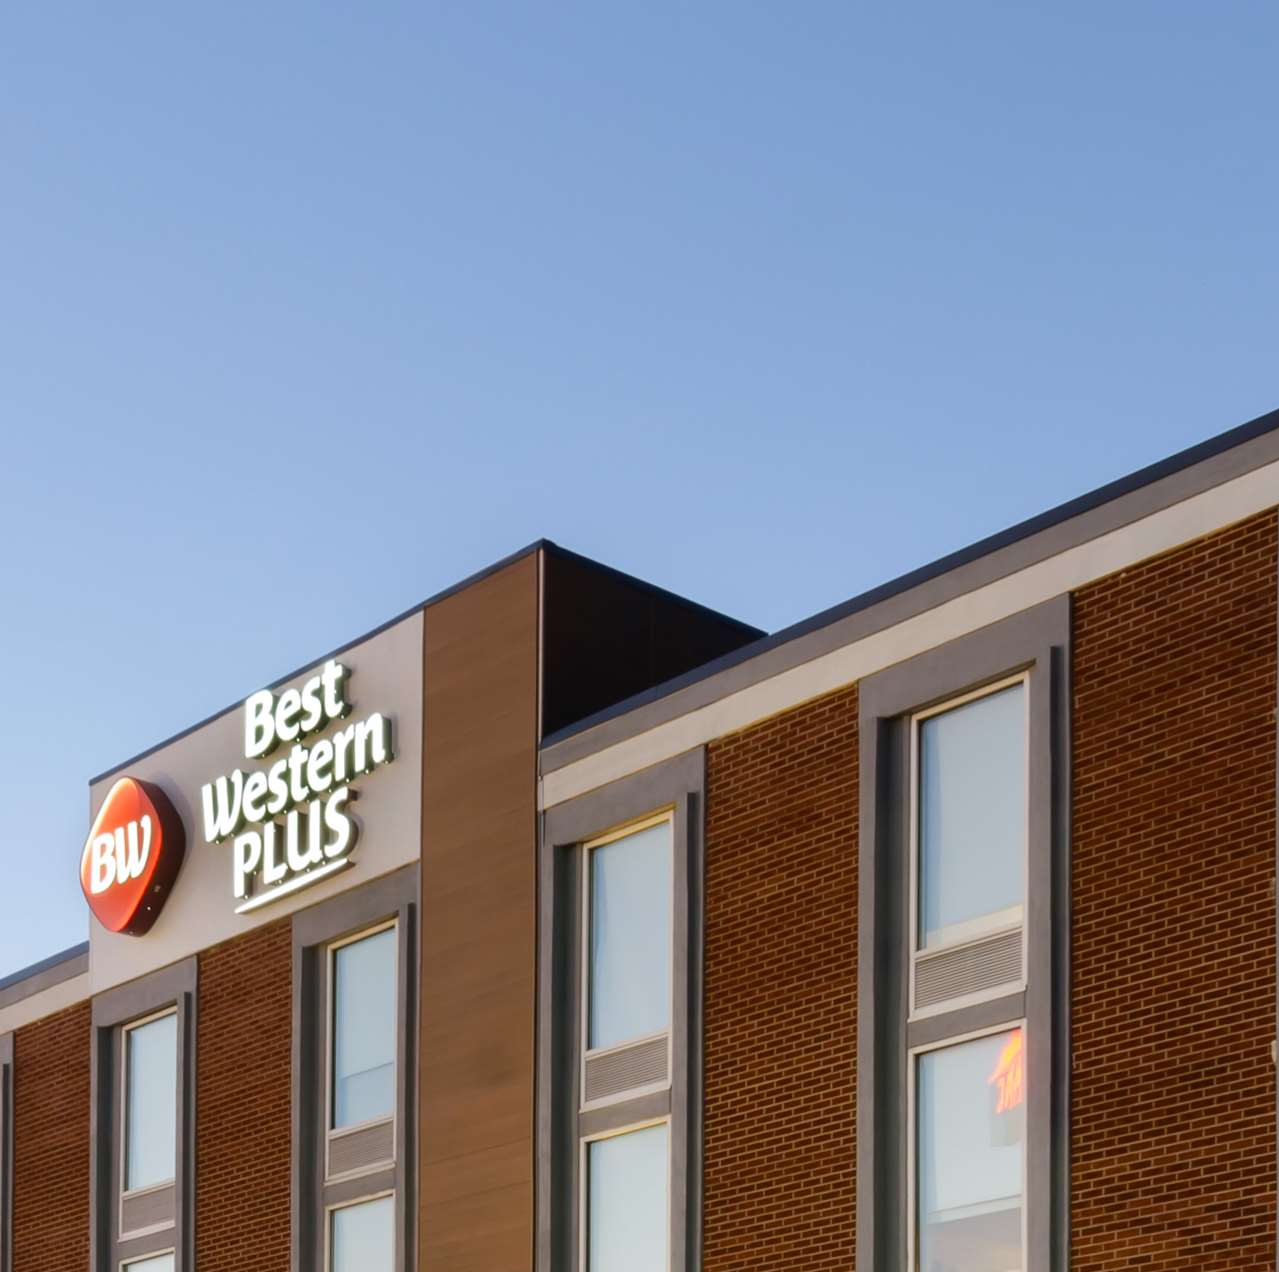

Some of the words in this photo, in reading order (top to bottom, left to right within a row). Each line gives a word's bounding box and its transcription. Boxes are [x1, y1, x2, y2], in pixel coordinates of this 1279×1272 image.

[245, 659, 351, 758] Best
[201, 712, 394, 844] Western
[90, 814, 152, 895] BW
[233, 786, 358, 899] PLUS
